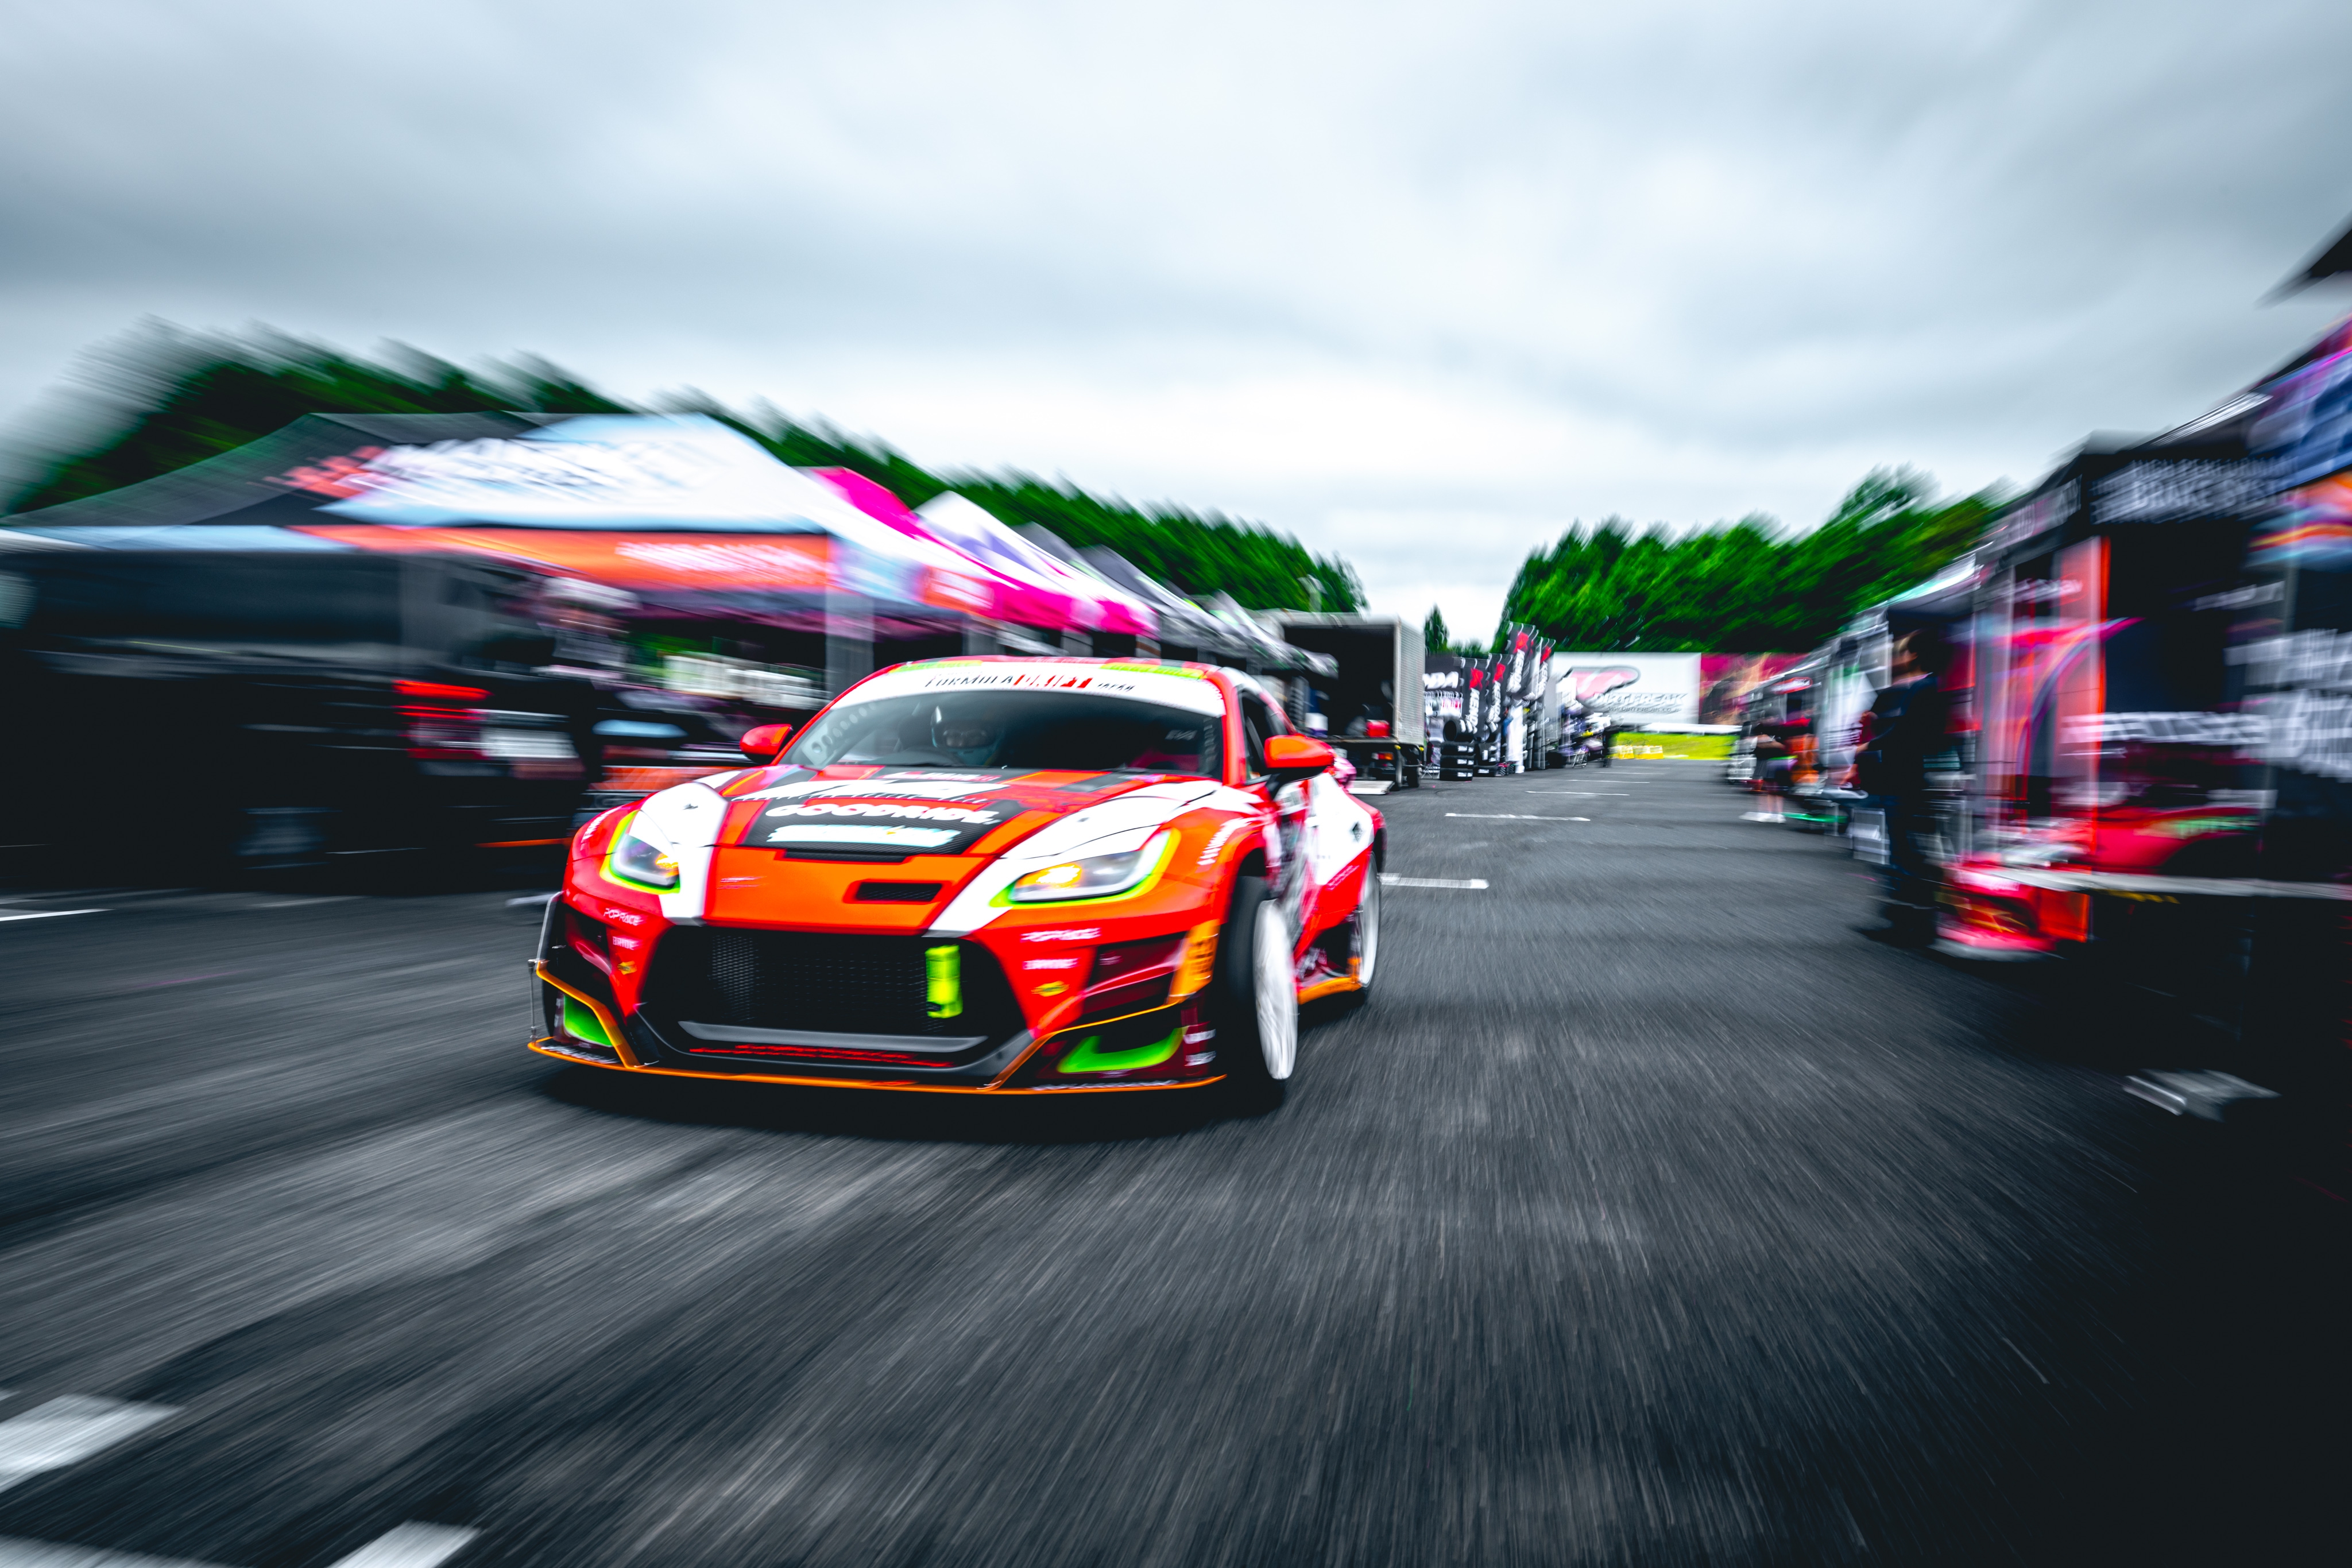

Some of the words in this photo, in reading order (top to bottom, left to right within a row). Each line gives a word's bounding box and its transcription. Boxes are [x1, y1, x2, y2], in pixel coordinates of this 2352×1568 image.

[924, 673, 1014, 687] FORMULA
[1012, 674, 1094, 690] DRIFT
[1097, 682, 1136, 692] JAPAN
[765, 804, 1000, 823] GOODRIDE
